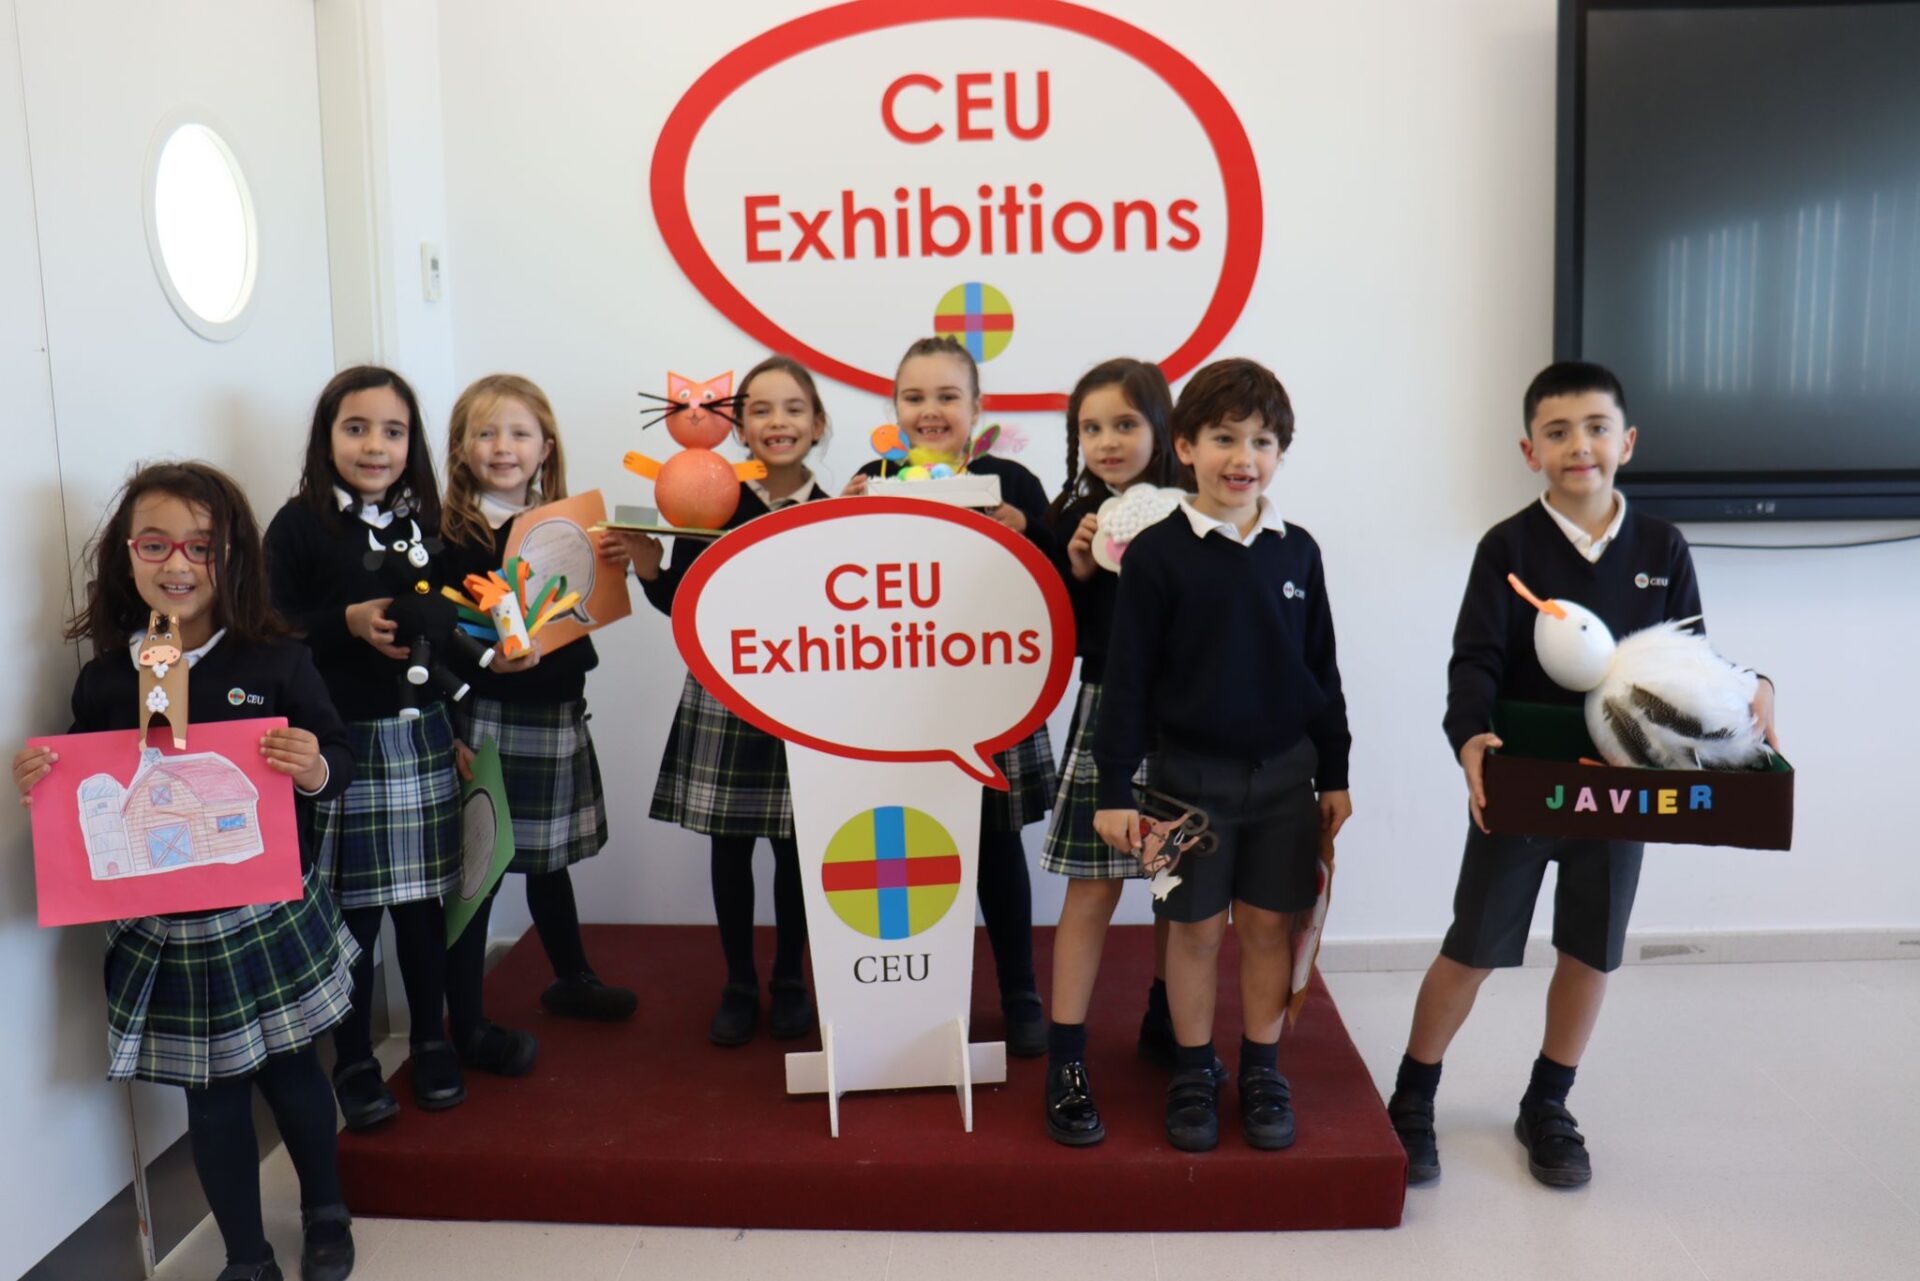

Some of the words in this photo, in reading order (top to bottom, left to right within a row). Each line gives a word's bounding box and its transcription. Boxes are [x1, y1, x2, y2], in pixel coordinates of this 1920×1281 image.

[881, 70, 1050, 144] CEU
[744, 183, 1201, 263] Exhibitions
[825, 562, 940, 611] CEU
[731, 621, 1041, 675] Exhibitions
[246, 694, 265, 706] CEU
[1545, 785, 1712, 814] JAVIER
[853, 953, 931, 984] CEU
